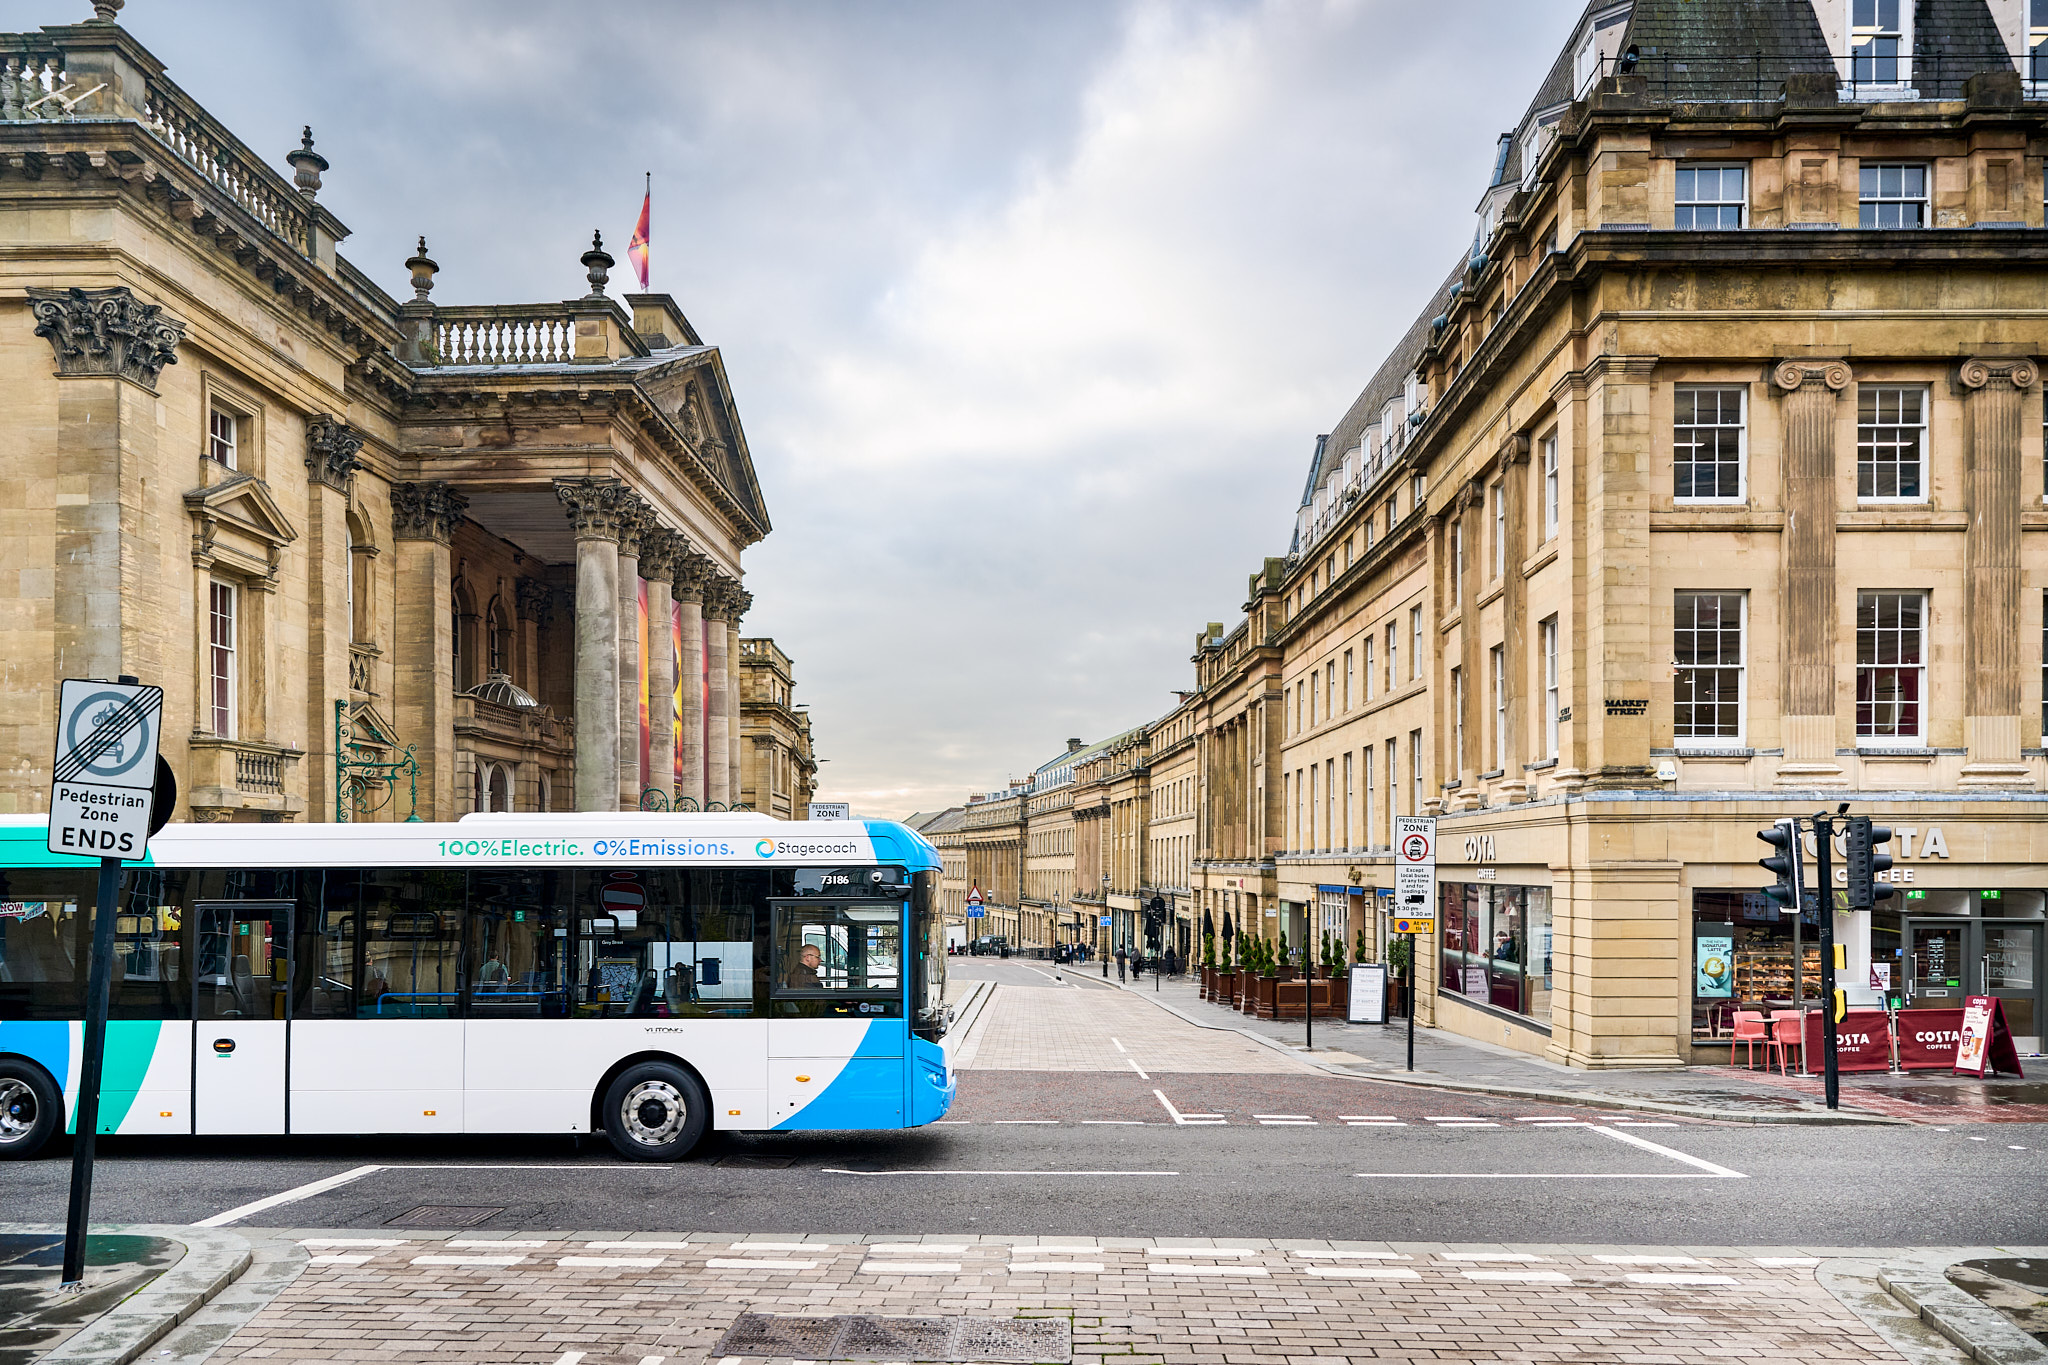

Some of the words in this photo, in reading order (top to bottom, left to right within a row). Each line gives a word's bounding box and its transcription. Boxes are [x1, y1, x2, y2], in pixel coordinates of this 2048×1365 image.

[1604, 699, 1649, 707] MARKET
[1606, 707, 1646, 715] STREET
[60, 788, 145, 808] Pedestrian
[80, 806, 119, 822] Zone
[816, 810, 840, 818] ZONE
[1403, 824, 1429, 832] ZONE
[62, 826, 134, 852] ENDS
[777, 841, 857, 856] Stagecoach
[1464, 835, 1496, 864] COSTA
[820, 875, 850, 885] 73186
[1477, 868, 1496, 880] COFFEE
[1835, 868, 1914, 883] CFEE
[0, 903, 23, 913] NOW
[1997, 938, 2021, 948] BEST
[1836, 1033, 1870, 1047] OSTA
[1915, 1030, 1960, 1044] COSTA
